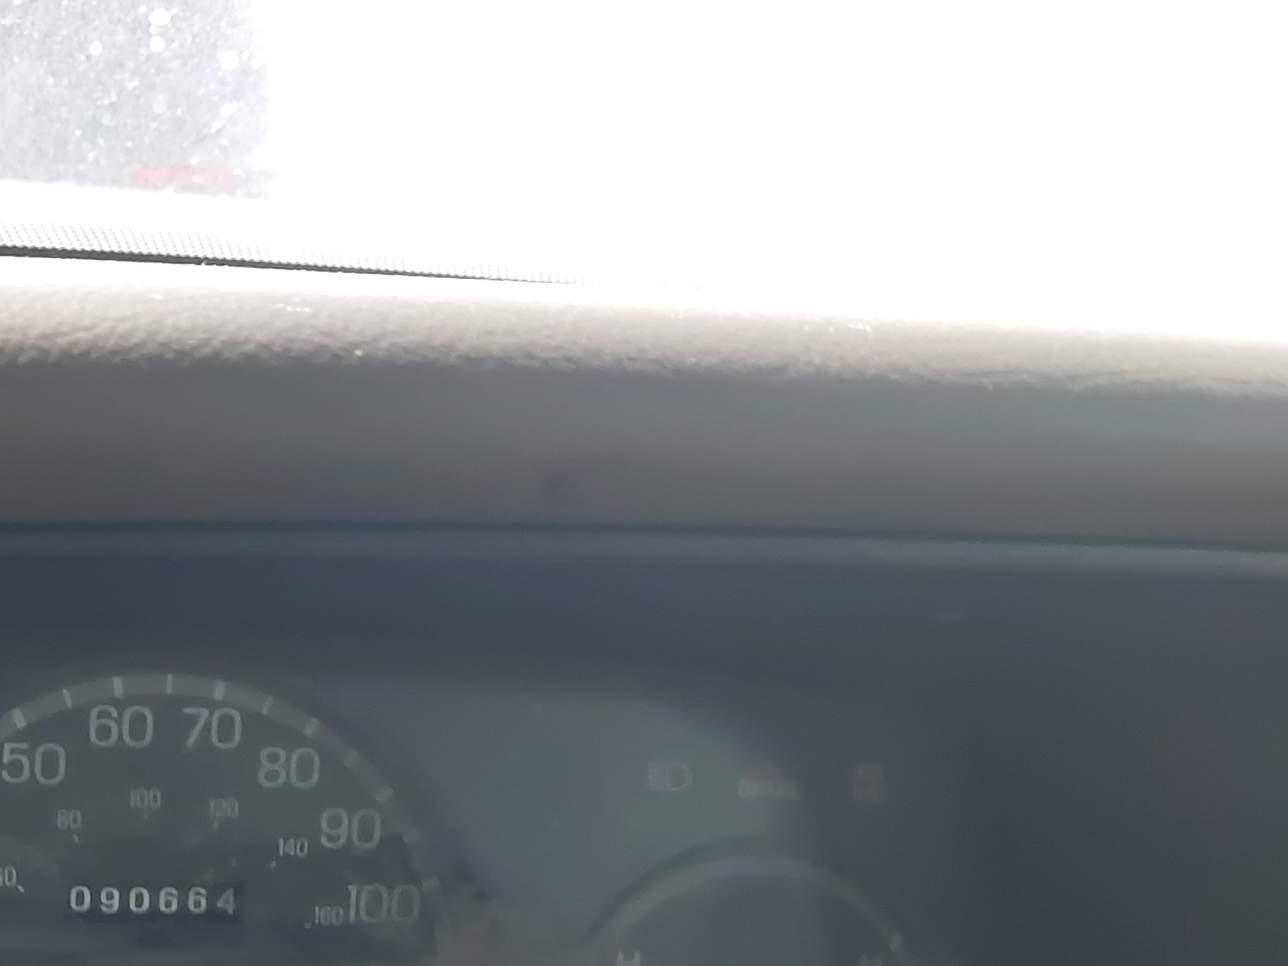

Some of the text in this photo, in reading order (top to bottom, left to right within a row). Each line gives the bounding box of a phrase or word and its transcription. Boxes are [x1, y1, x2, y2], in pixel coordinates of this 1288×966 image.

[88, 704, 154, 748] 60
[182, 707, 243, 749] 70
[0, 742, 67, 785] 50
[257, 746, 321, 789] 80
[129, 787, 161, 810] 100
[278, 837, 309, 858] 140
[319, 808, 382, 850] 90
[69, 885, 238, 915] 090664
[347, 883, 422, 923] 100
